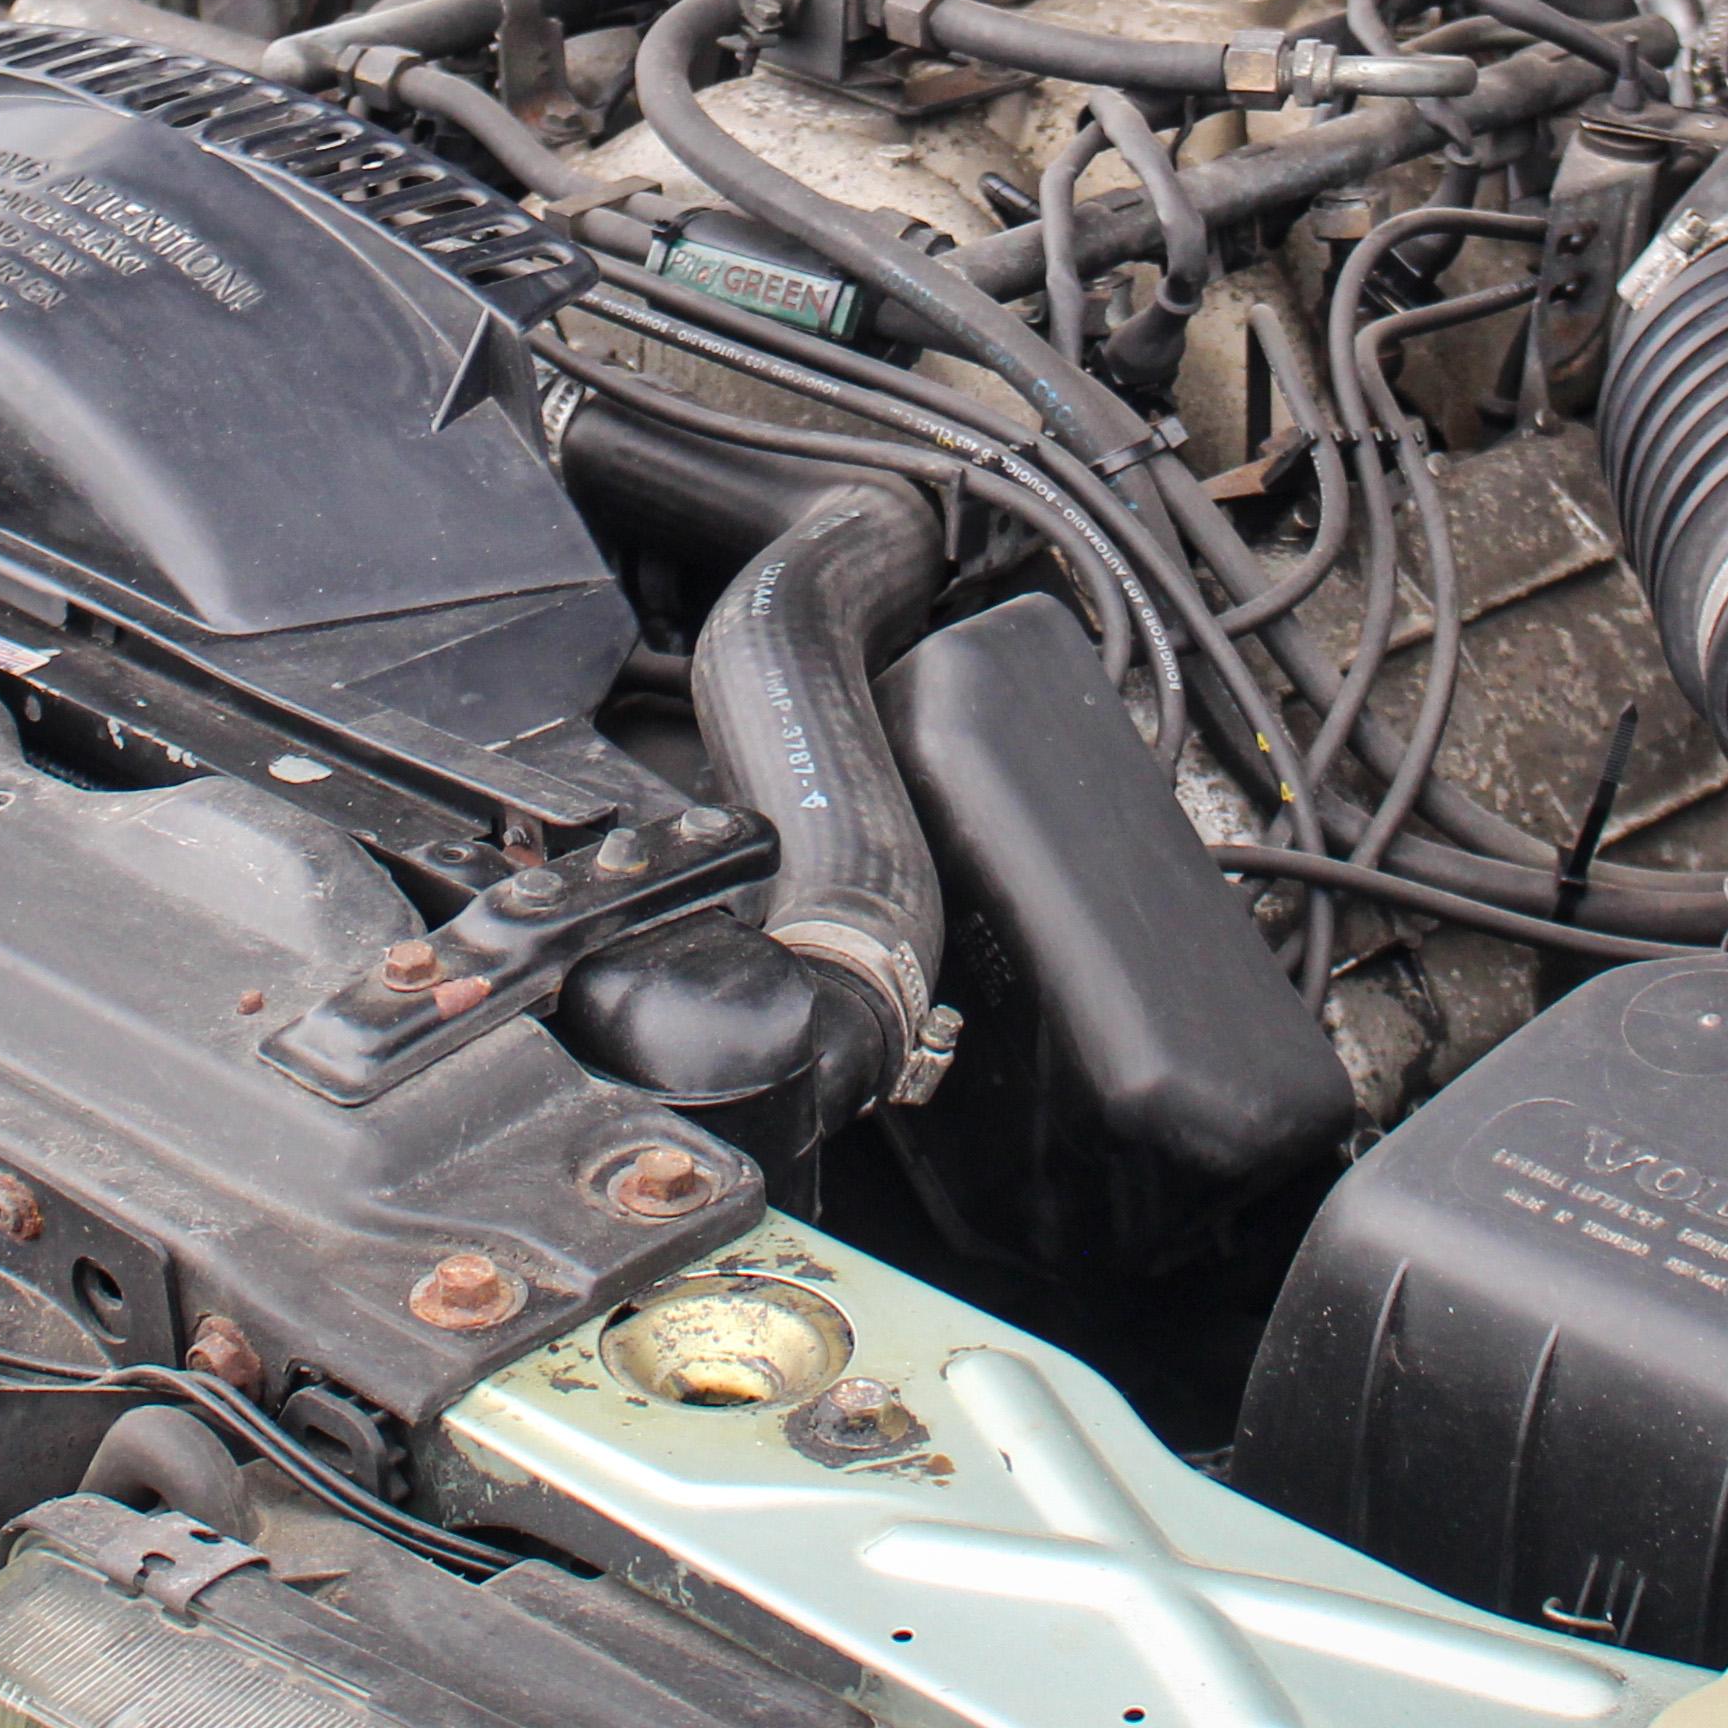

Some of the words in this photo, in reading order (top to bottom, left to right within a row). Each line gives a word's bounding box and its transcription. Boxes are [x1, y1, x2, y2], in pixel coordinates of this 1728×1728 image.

[723, 264, 832, 320] GREEN
[677, 330, 744, 362] AUTORADIO
[1062, 506, 1130, 578] AUTORADIO
[1121, 578, 1145, 608] 403
[1140, 608, 1181, 691] BOUGICORD
